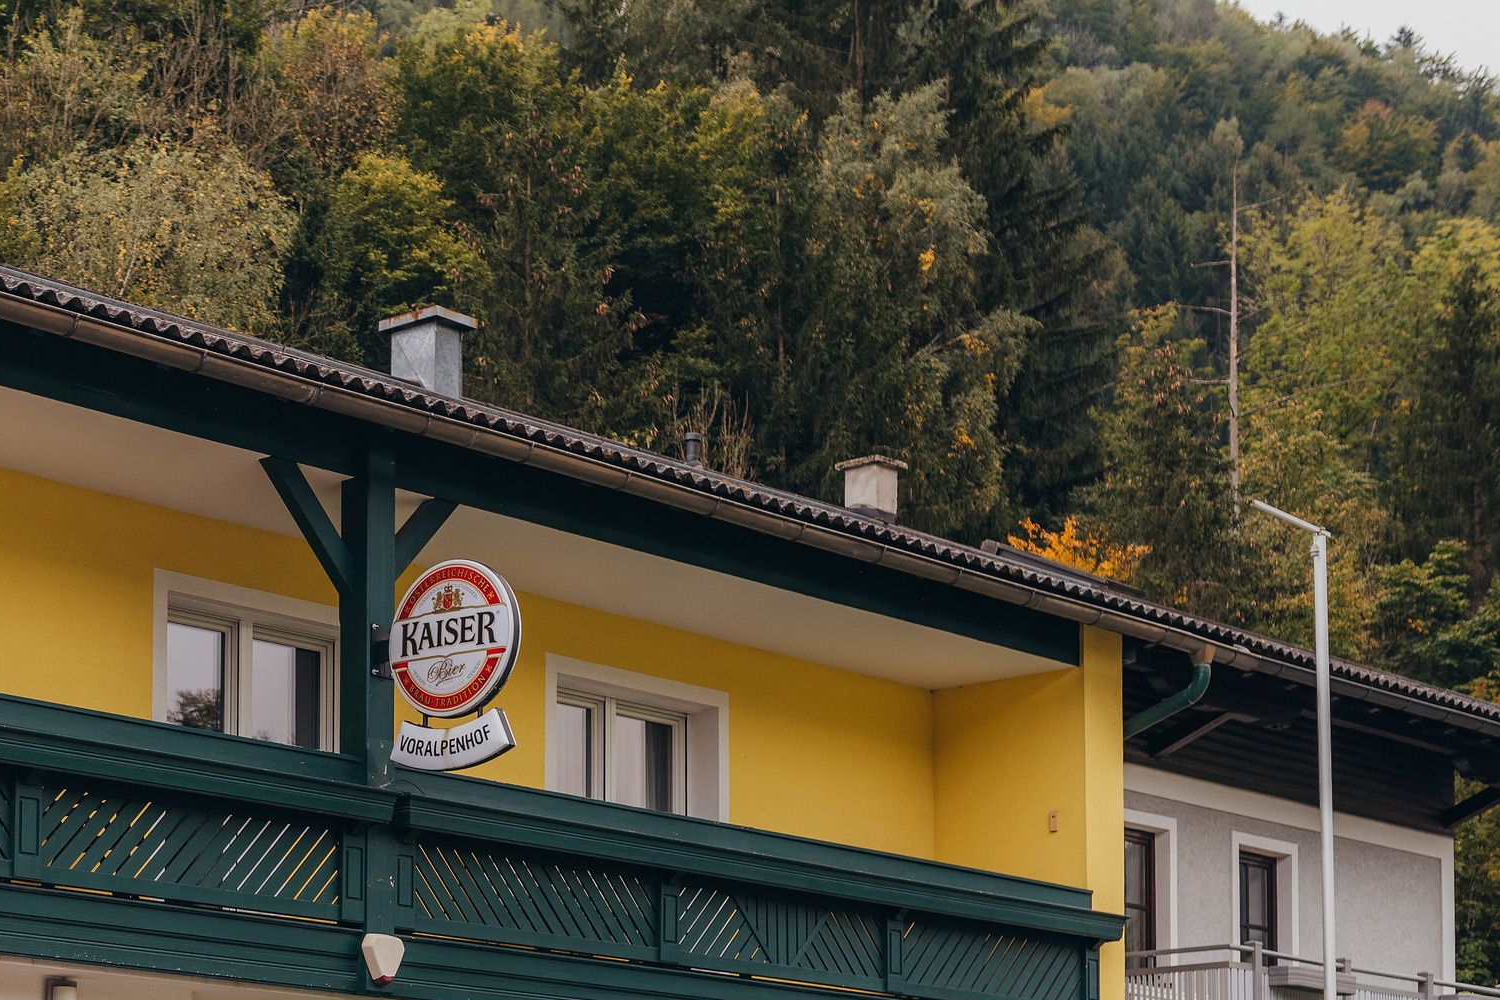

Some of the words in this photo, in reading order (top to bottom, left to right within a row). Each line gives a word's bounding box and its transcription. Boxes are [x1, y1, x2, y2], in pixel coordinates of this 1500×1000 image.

[400, 611, 498, 658] KAISER
[427, 658, 466, 687] Bier
[399, 724, 491, 757] VORALPENHOF
